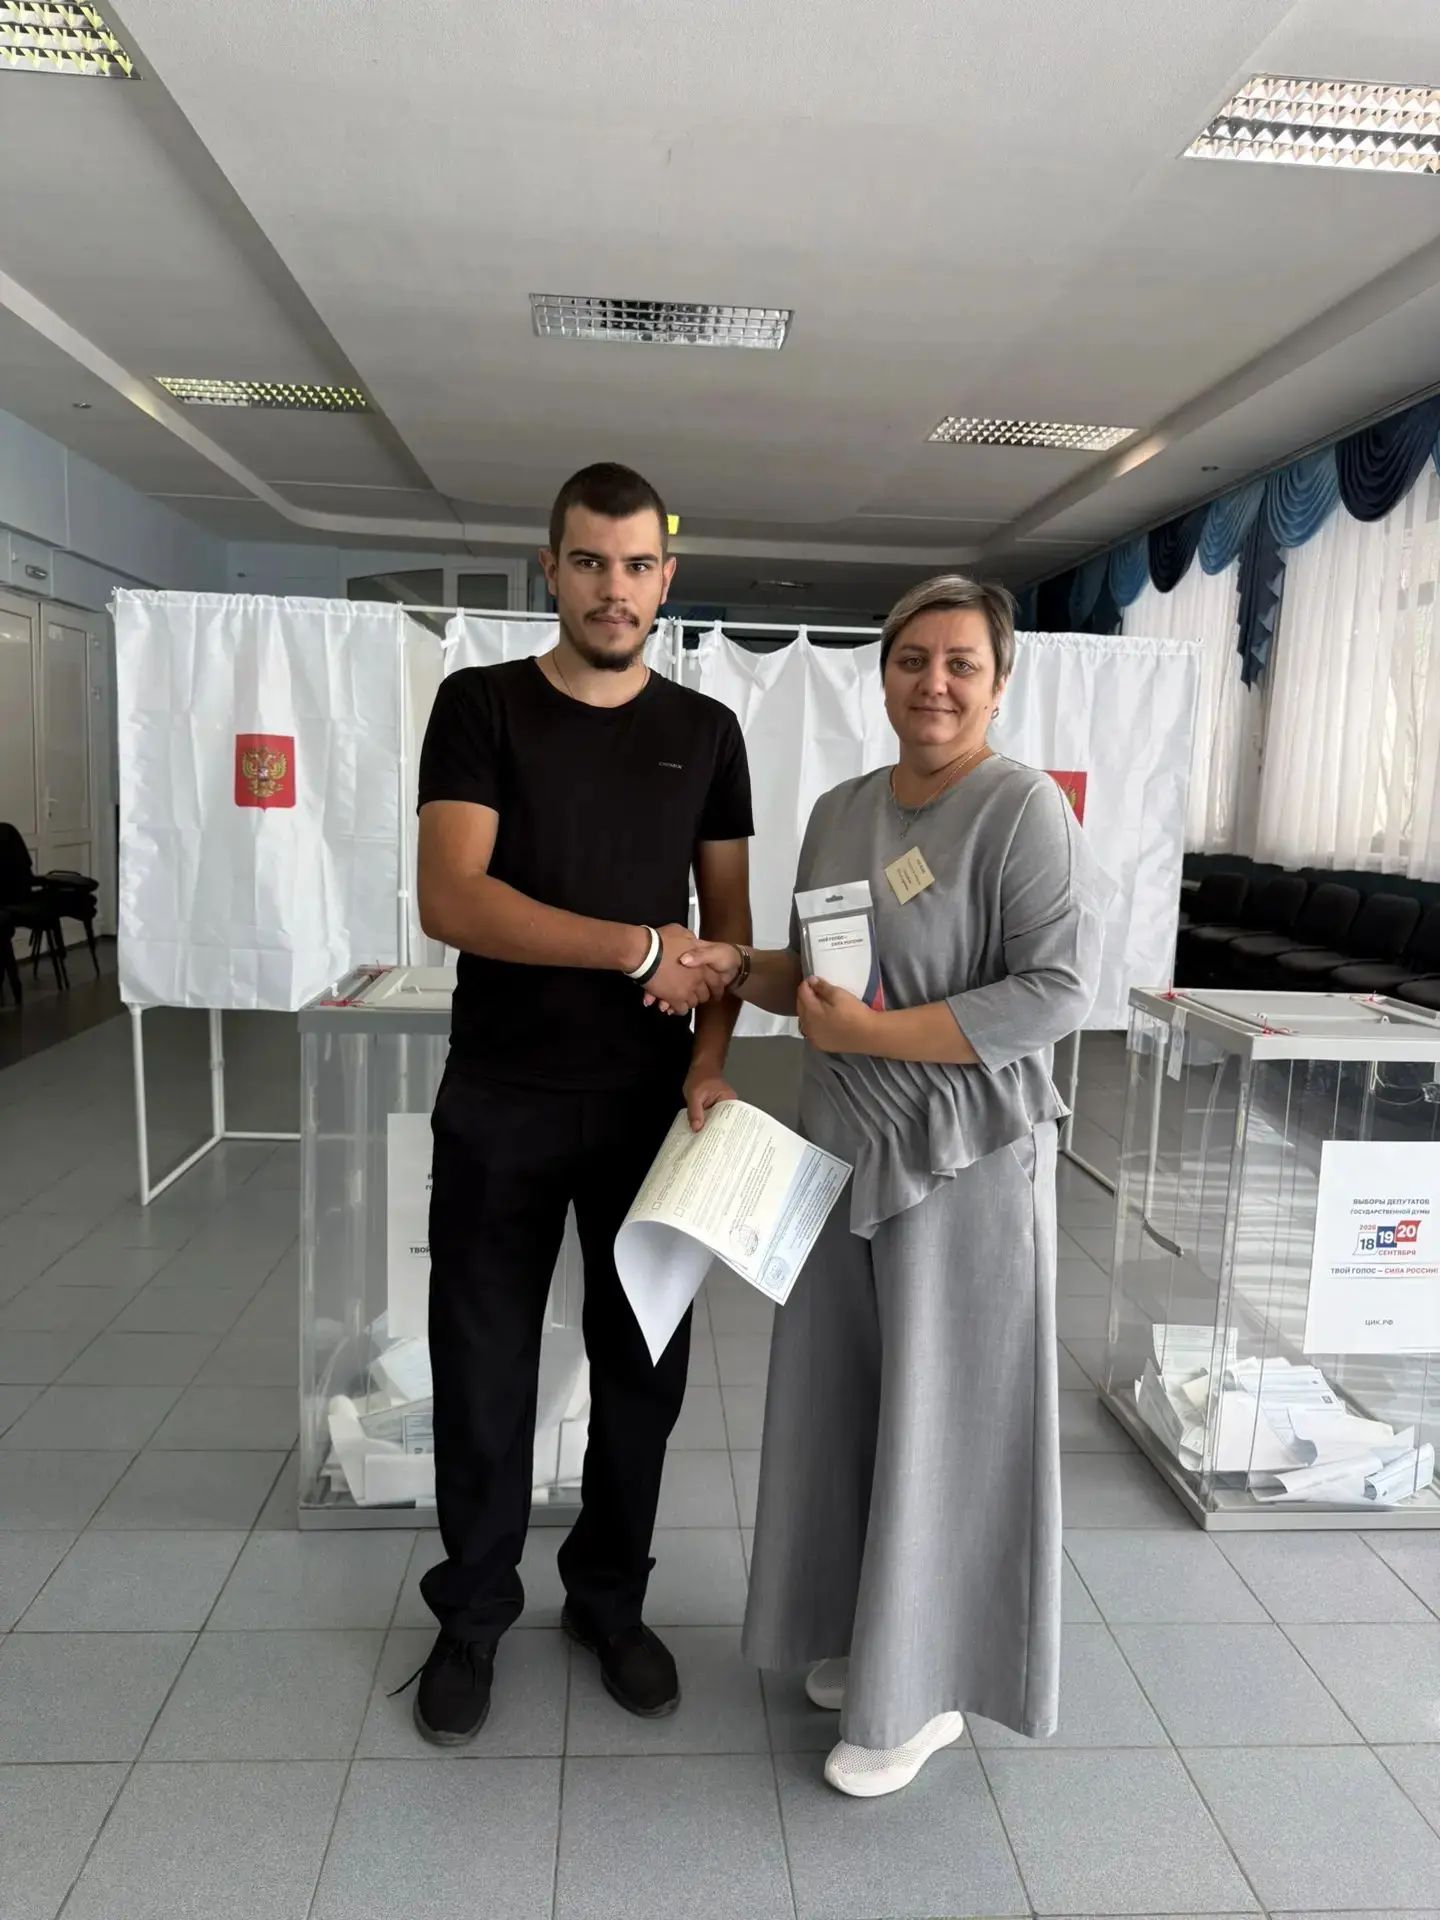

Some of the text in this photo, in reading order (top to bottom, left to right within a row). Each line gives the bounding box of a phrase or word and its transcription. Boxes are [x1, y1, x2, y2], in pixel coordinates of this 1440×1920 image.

[1350, 1207, 1411, 1215] ГОСУДАРСТВЕННОЙ
[1378, 1230, 1394, 1244] 19
[1397, 1224, 1417, 1238] 20
[1360, 1238, 1375, 1250] 18
[1331, 1266, 1351, 1274] ТВОЙ
